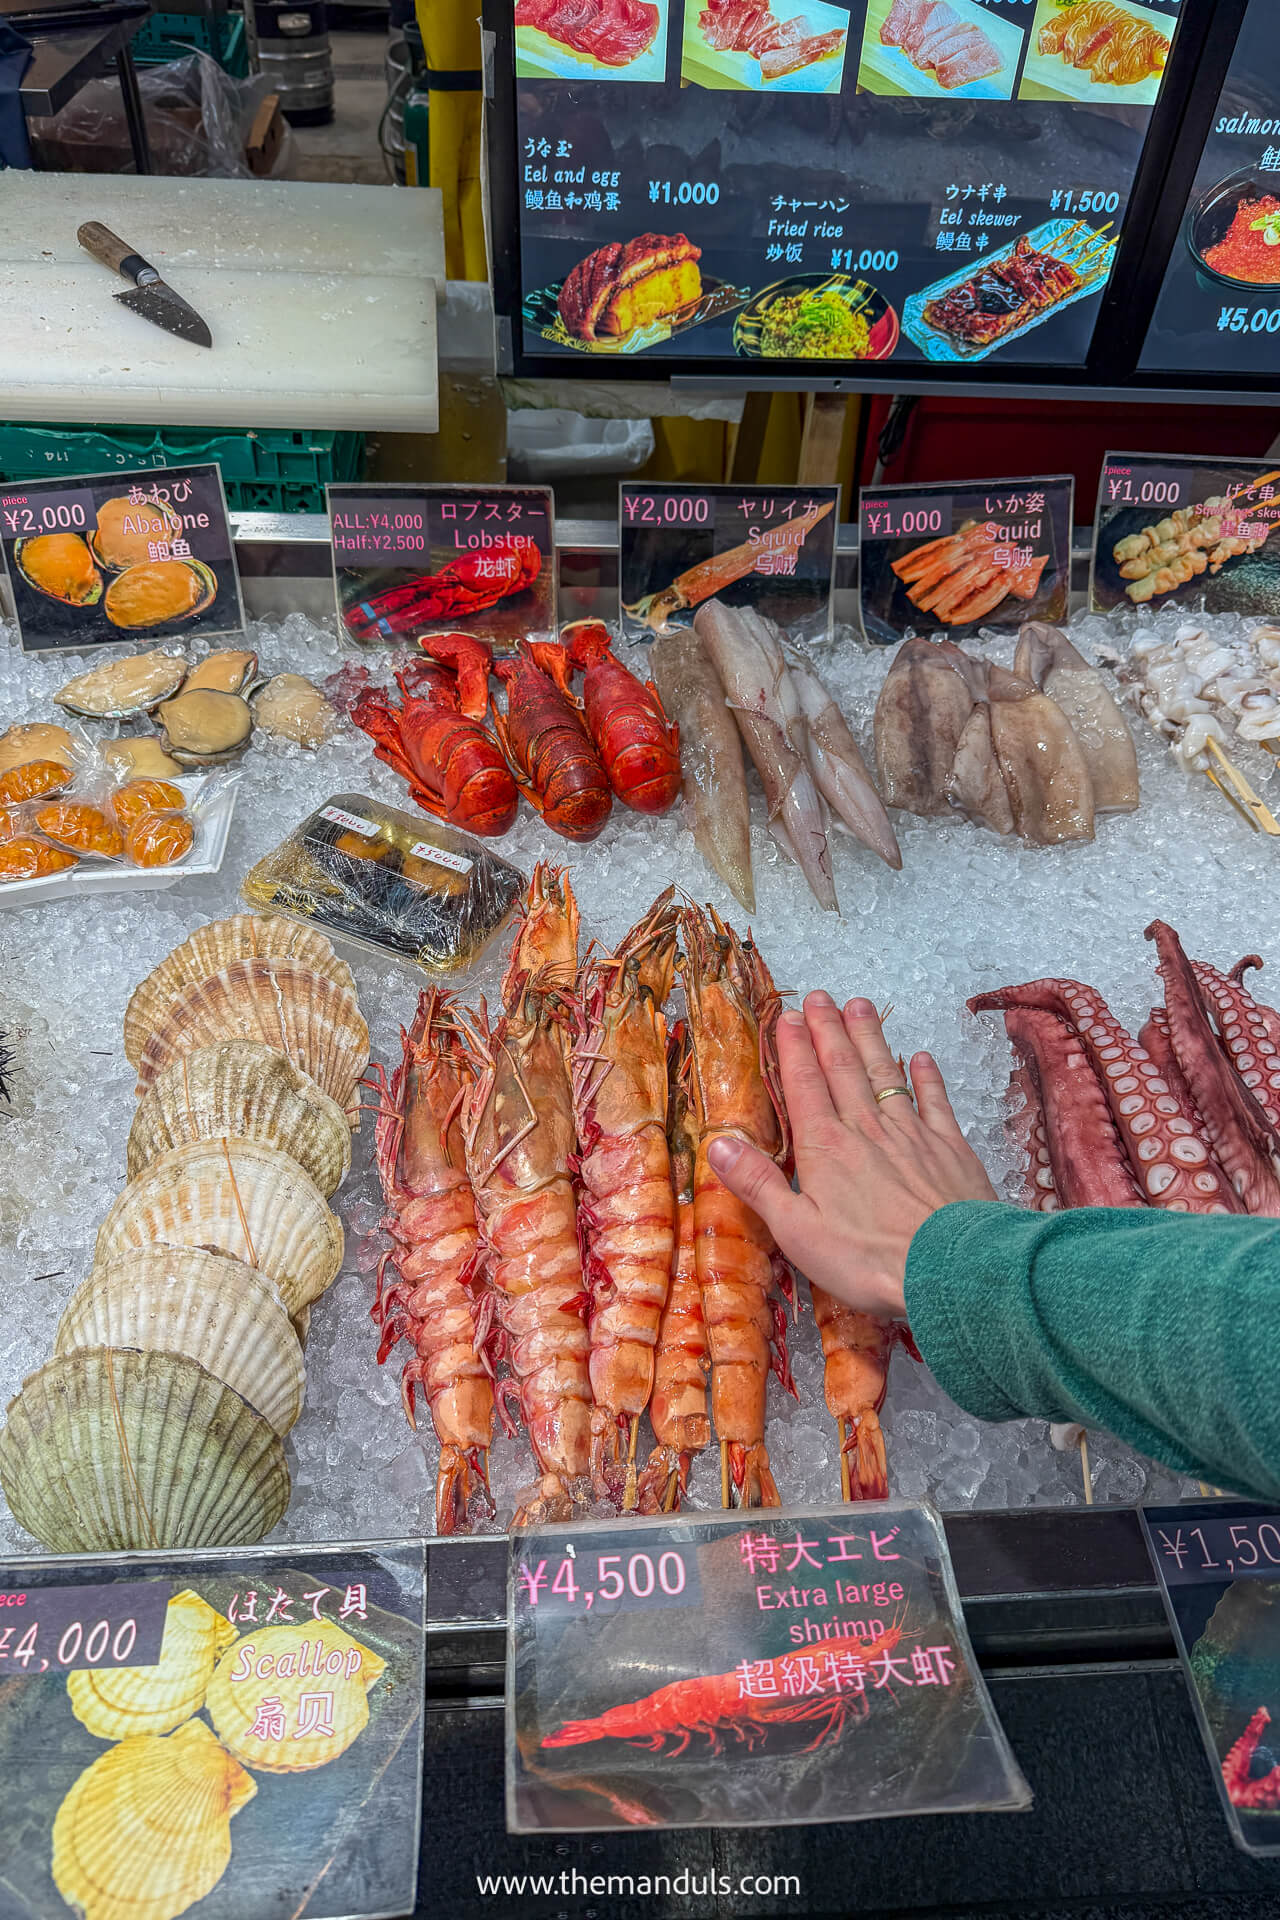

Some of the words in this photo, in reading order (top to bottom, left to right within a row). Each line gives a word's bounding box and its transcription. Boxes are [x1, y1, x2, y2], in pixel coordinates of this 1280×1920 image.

[524, 164, 548, 183] Eel
[554, 166, 585, 184] and
[592, 171, 621, 187] egg
[649, 182, 720, 206] ¥1,000
[771, 195, 850, 213] チャーハン
[945, 182, 1008, 204] ウナギ串
[1050, 189, 1119, 213] ¥1,500
[768, 219, 808, 238] Fried
[814, 221, 843, 238] rice
[939, 208, 964, 226] Eel
[968, 209, 1022, 227] skewer
[765, 242, 803, 263] 炒饭
[830, 248, 899, 272] ¥1,000
[128, 479, 193, 506] あわび
[984, 491, 1046, 515] いか姿
[1107, 479, 1180, 505] ¥1,000
[1225, 483, 1275, 502] げそ串
[4, 503, 86, 534] ¥2,000
[333, 513, 423, 531] ALL:¥4,000
[441, 500, 545, 522] ロブスター
[624, 497, 709, 526] ¥2,000
[737, 500, 820, 520] ヤリイカ
[122, 510, 210, 535] Abalone
[867, 509, 942, 537] ¥1,000
[985, 520, 1042, 543] Squid
[334, 535, 425, 551] Half:¥2,500
[454, 529, 534, 550] Lobster
[747, 526, 806, 549] Squid
[474, 557, 517, 579] 龙虾
[754, 553, 798, 577] 乌贼
[992, 546, 1033, 569] 乌贼
[740, 1526, 902, 1575] 特大エビ
[519, 1551, 687, 1610] ¥4,500
[227, 1584, 369, 1623] ほたて貝
[756, 1584, 829, 1611] Extra
[837, 1579, 905, 1608] large
[789, 1615, 885, 1644] shrimp
[229, 1639, 364, 1682] Scallop
[734, 1645, 957, 1700] 超級特大虾
[245, 1690, 336, 1743] 扇贝
